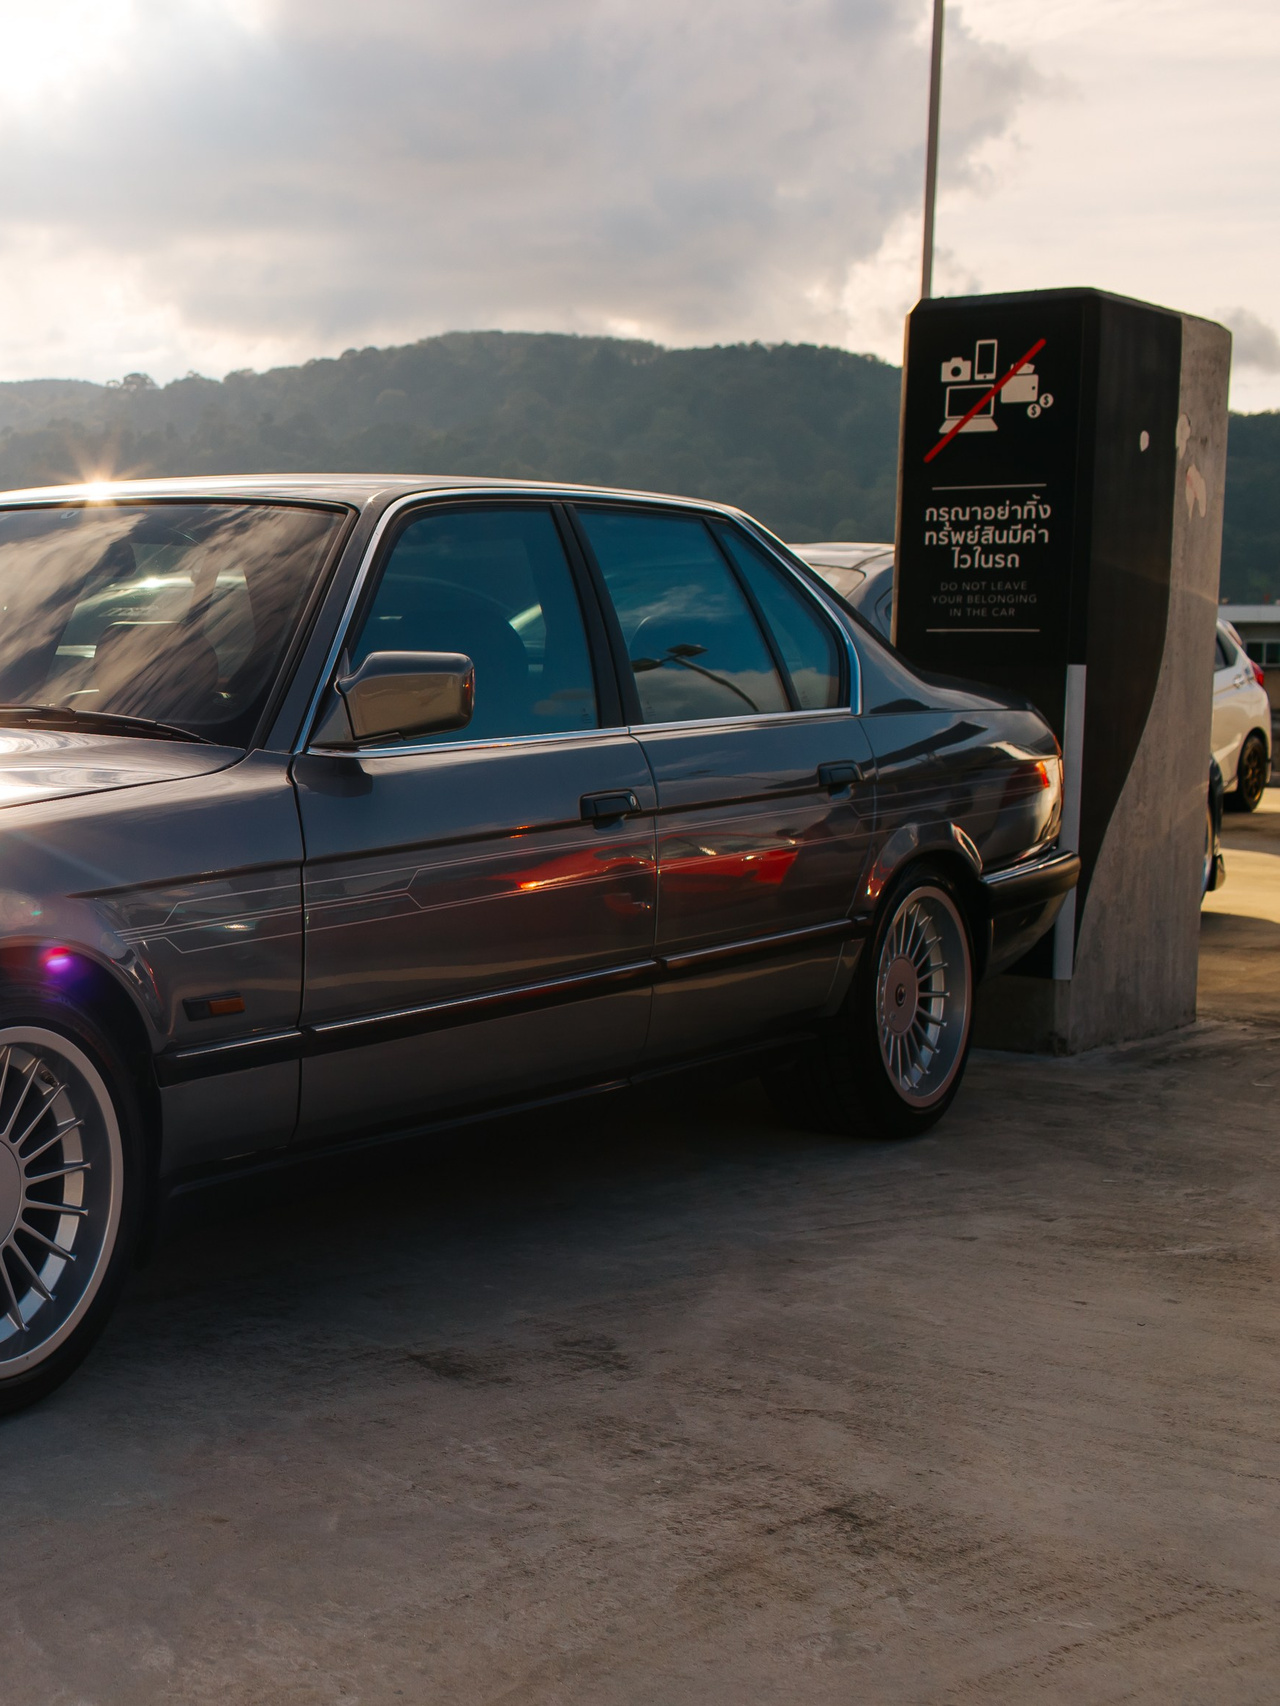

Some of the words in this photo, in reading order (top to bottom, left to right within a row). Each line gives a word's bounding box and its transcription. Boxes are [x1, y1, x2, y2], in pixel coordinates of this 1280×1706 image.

[924, 523, 1050, 546] ทรัพย์สินมีค่า
[940, 582, 958, 592] DO
[962, 581, 988, 591] NOT
[991, 580, 1028, 591] LEAVE
[931, 595, 963, 604] YOUR
[967, 594, 1038, 604] BELONGING
[949, 608, 961, 617] IN
[966, 607, 988, 617] THE
[991, 607, 1016, 617] CAR
